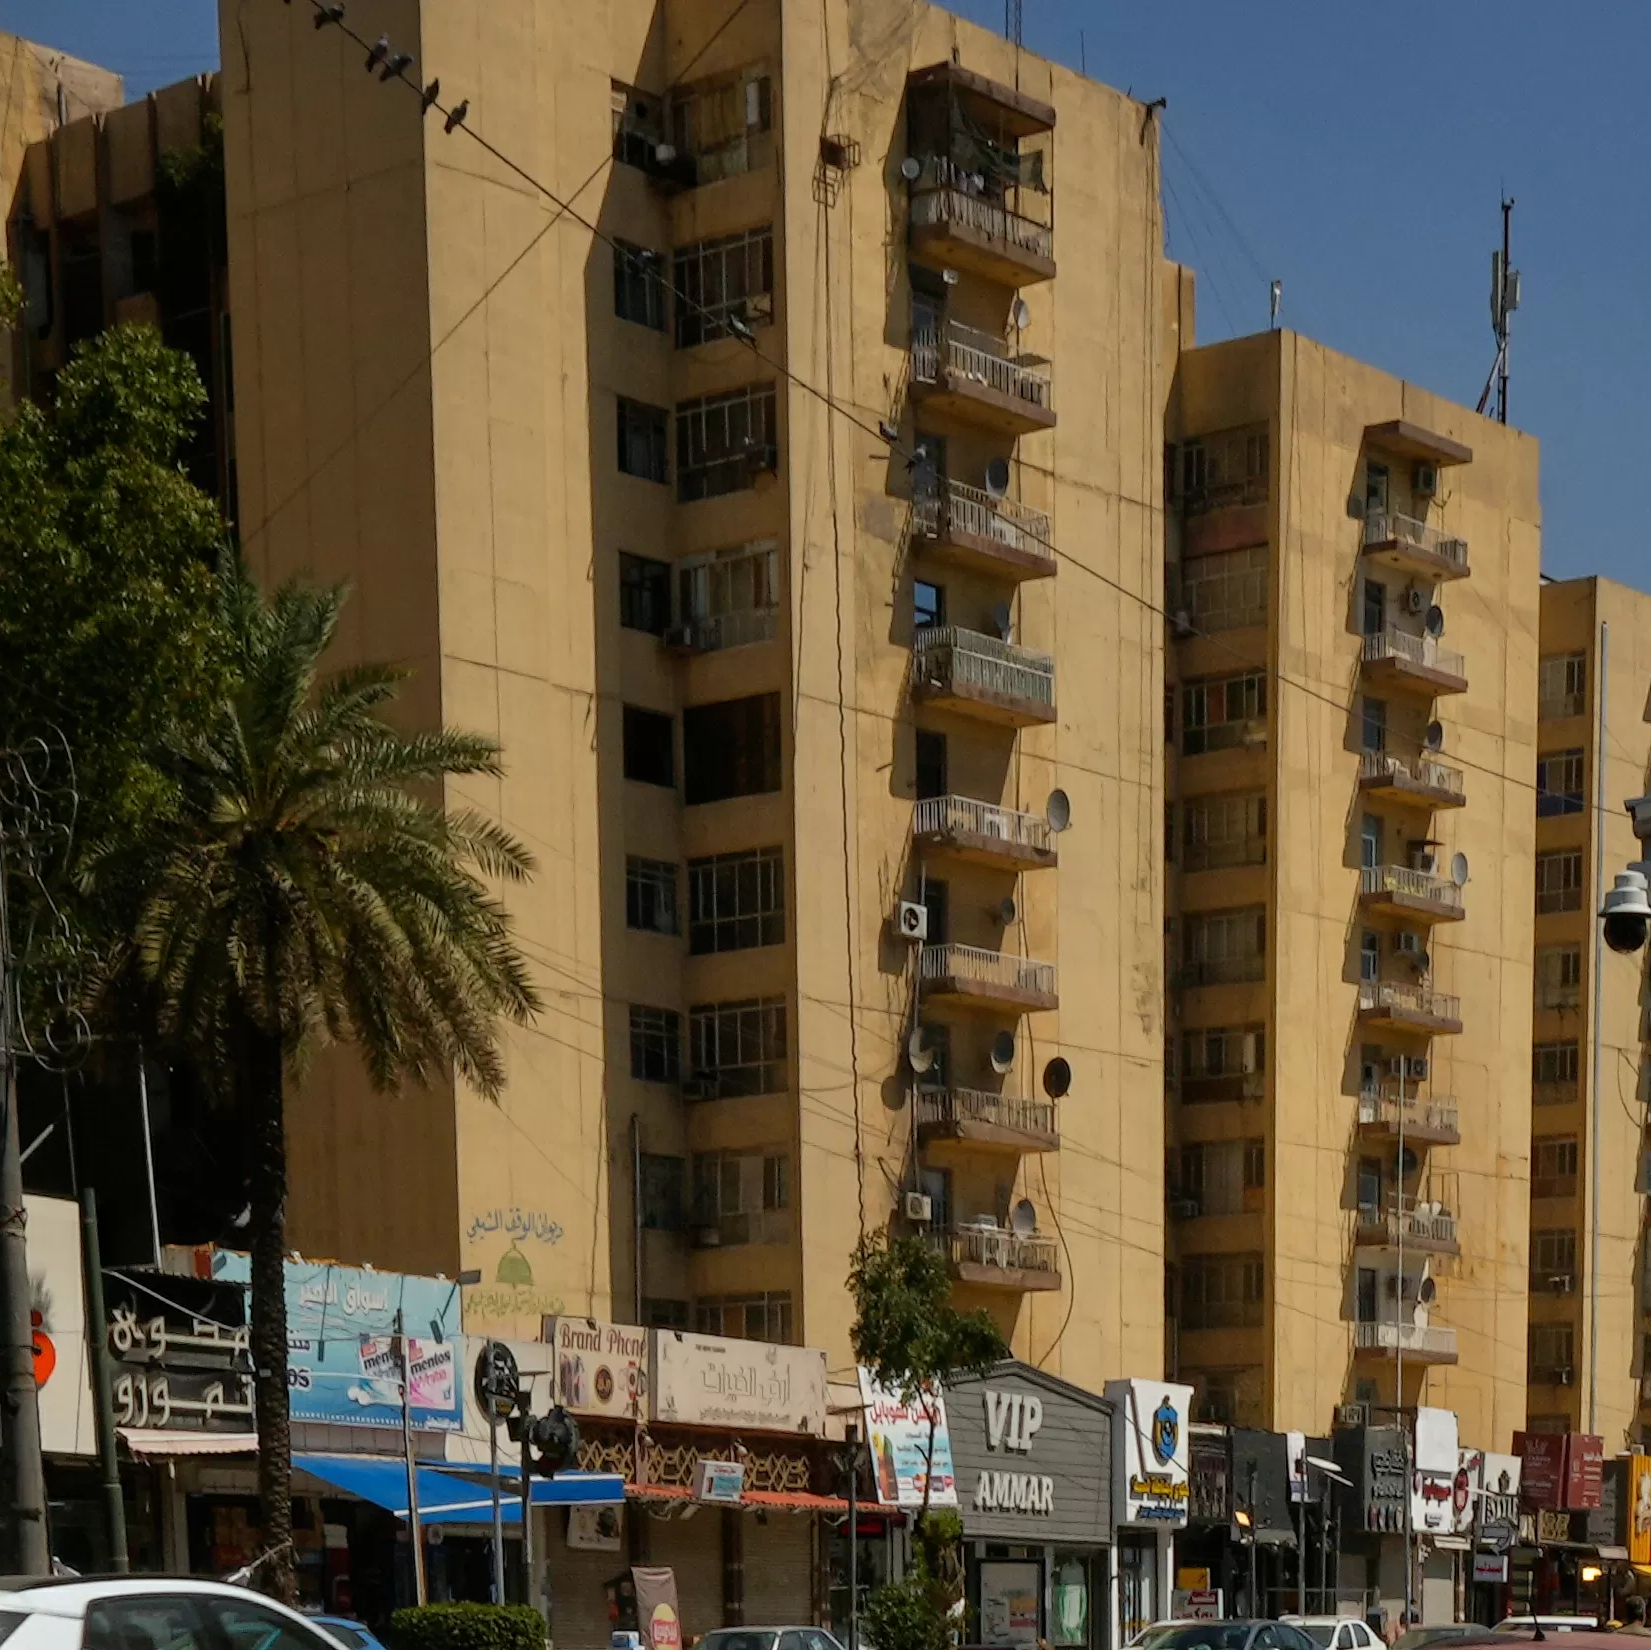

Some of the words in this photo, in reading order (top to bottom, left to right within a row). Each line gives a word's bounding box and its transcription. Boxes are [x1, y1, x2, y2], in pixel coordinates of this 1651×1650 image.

[560, 1322, 600, 1351] Brand
[606, 1328, 647, 1359] Phone
[983, 1389, 1043, 1452] VIP
[974, 1470, 1055, 1513] AMMAR
